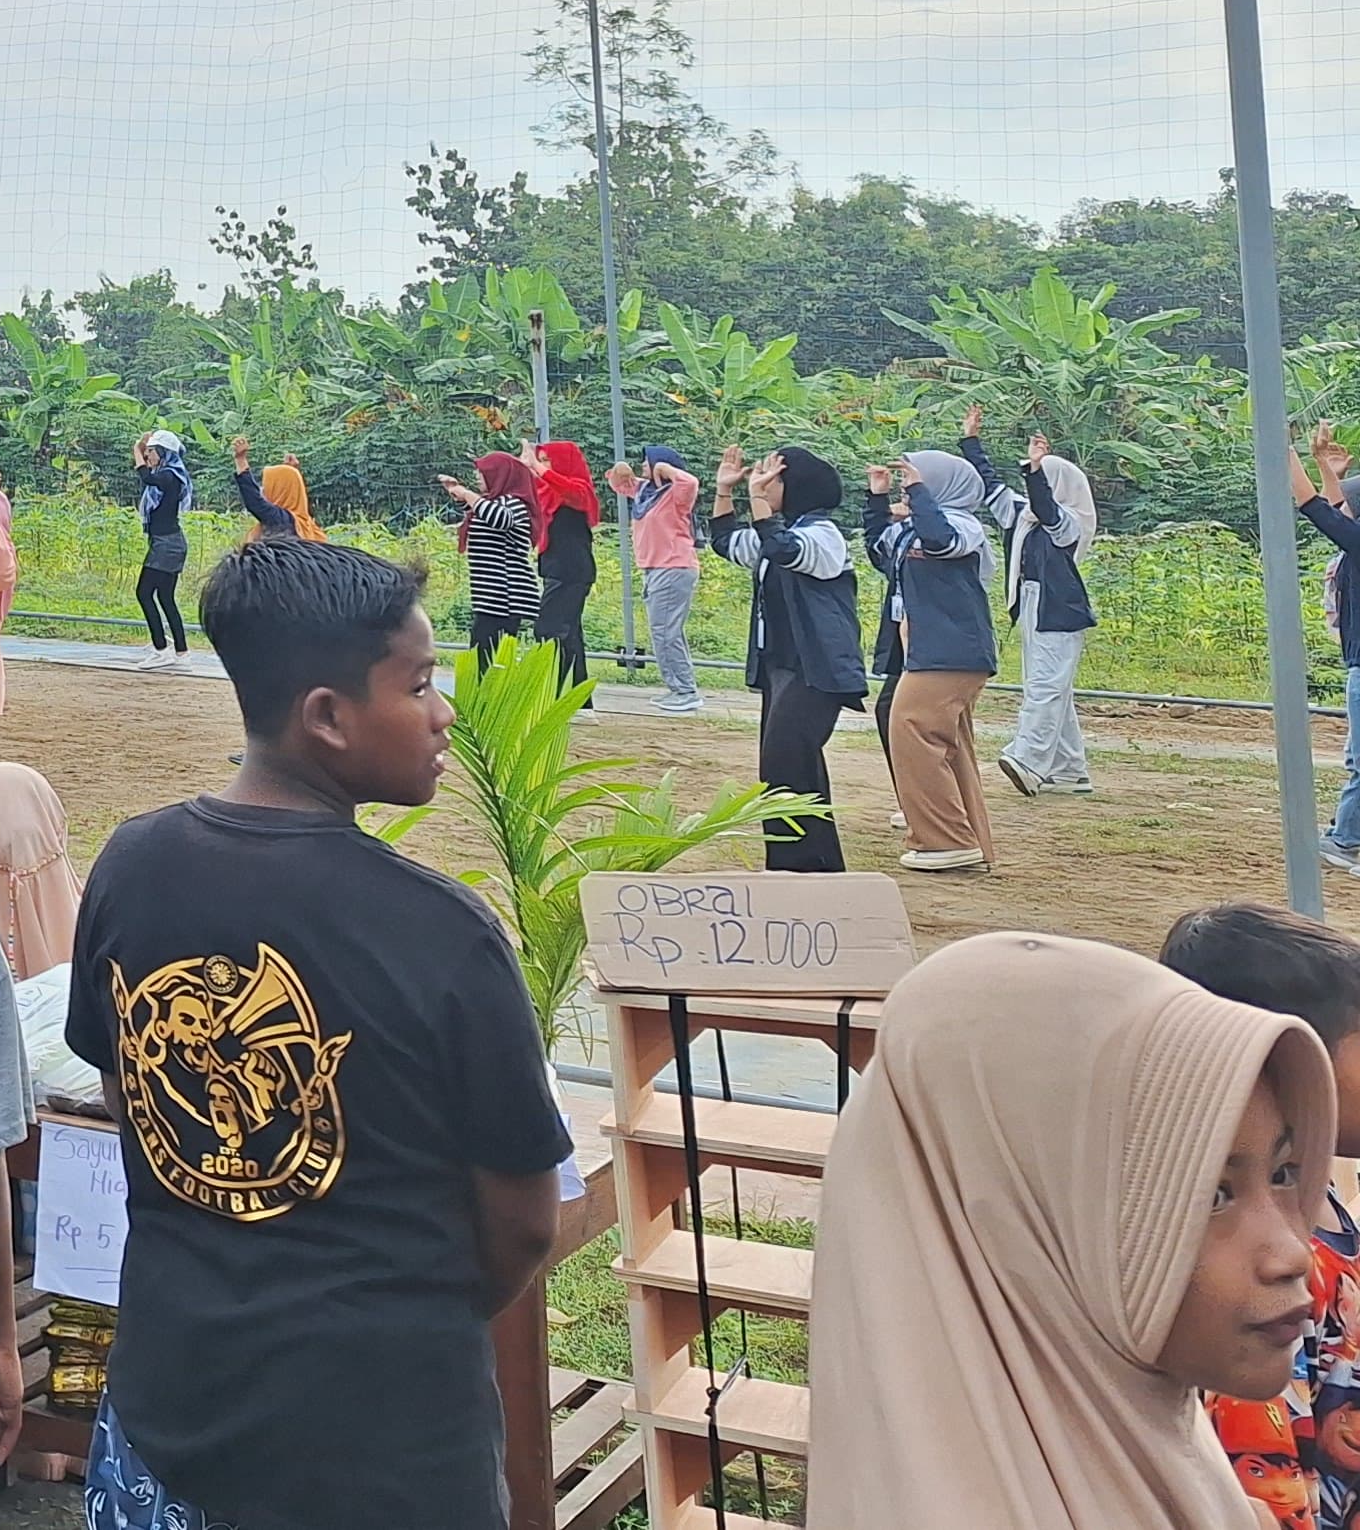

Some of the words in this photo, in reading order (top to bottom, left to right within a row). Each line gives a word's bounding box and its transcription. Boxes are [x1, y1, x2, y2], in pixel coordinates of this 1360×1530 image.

[611, 912, 683, 978] Rp
[53, 1128, 121, 1169] Sayur
[200, 1152, 259, 1178] 2020
